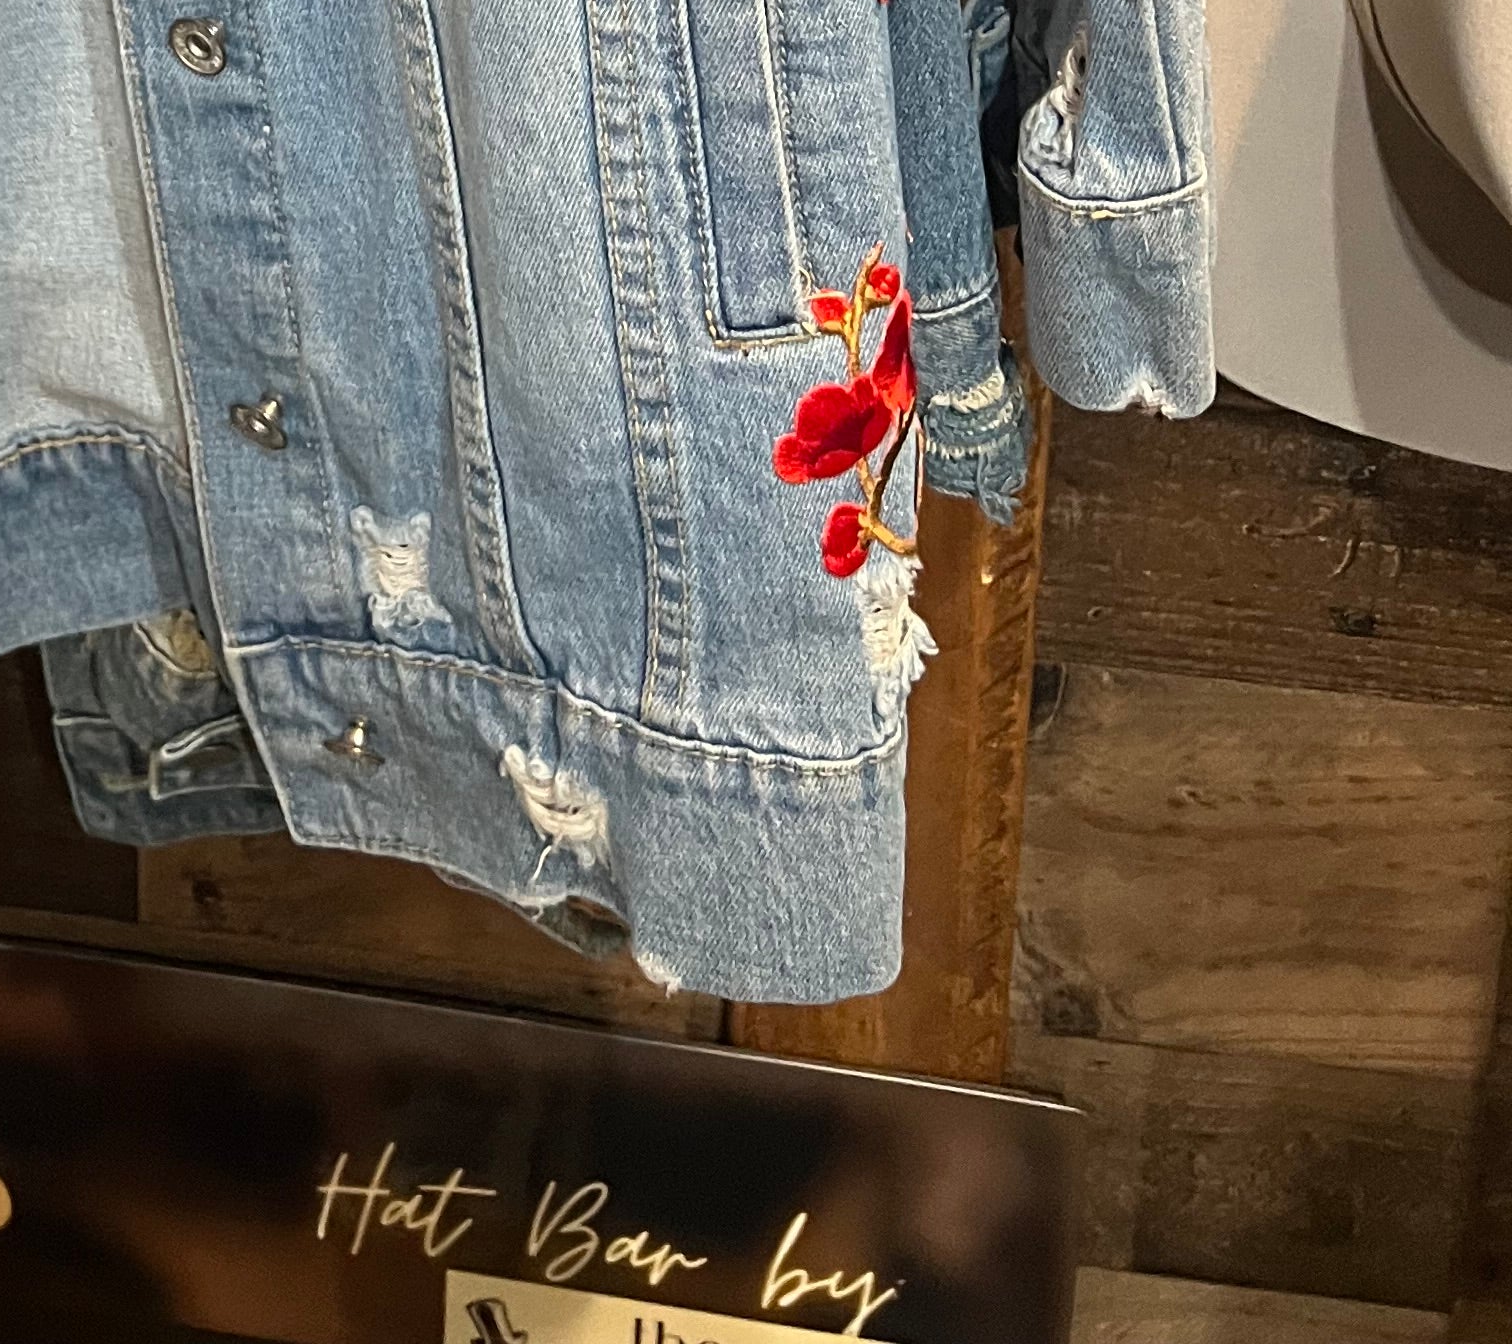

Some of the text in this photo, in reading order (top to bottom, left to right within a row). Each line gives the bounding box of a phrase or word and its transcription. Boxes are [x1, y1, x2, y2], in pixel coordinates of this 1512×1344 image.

[316, 1141, 902, 1338] Hat Bar by
